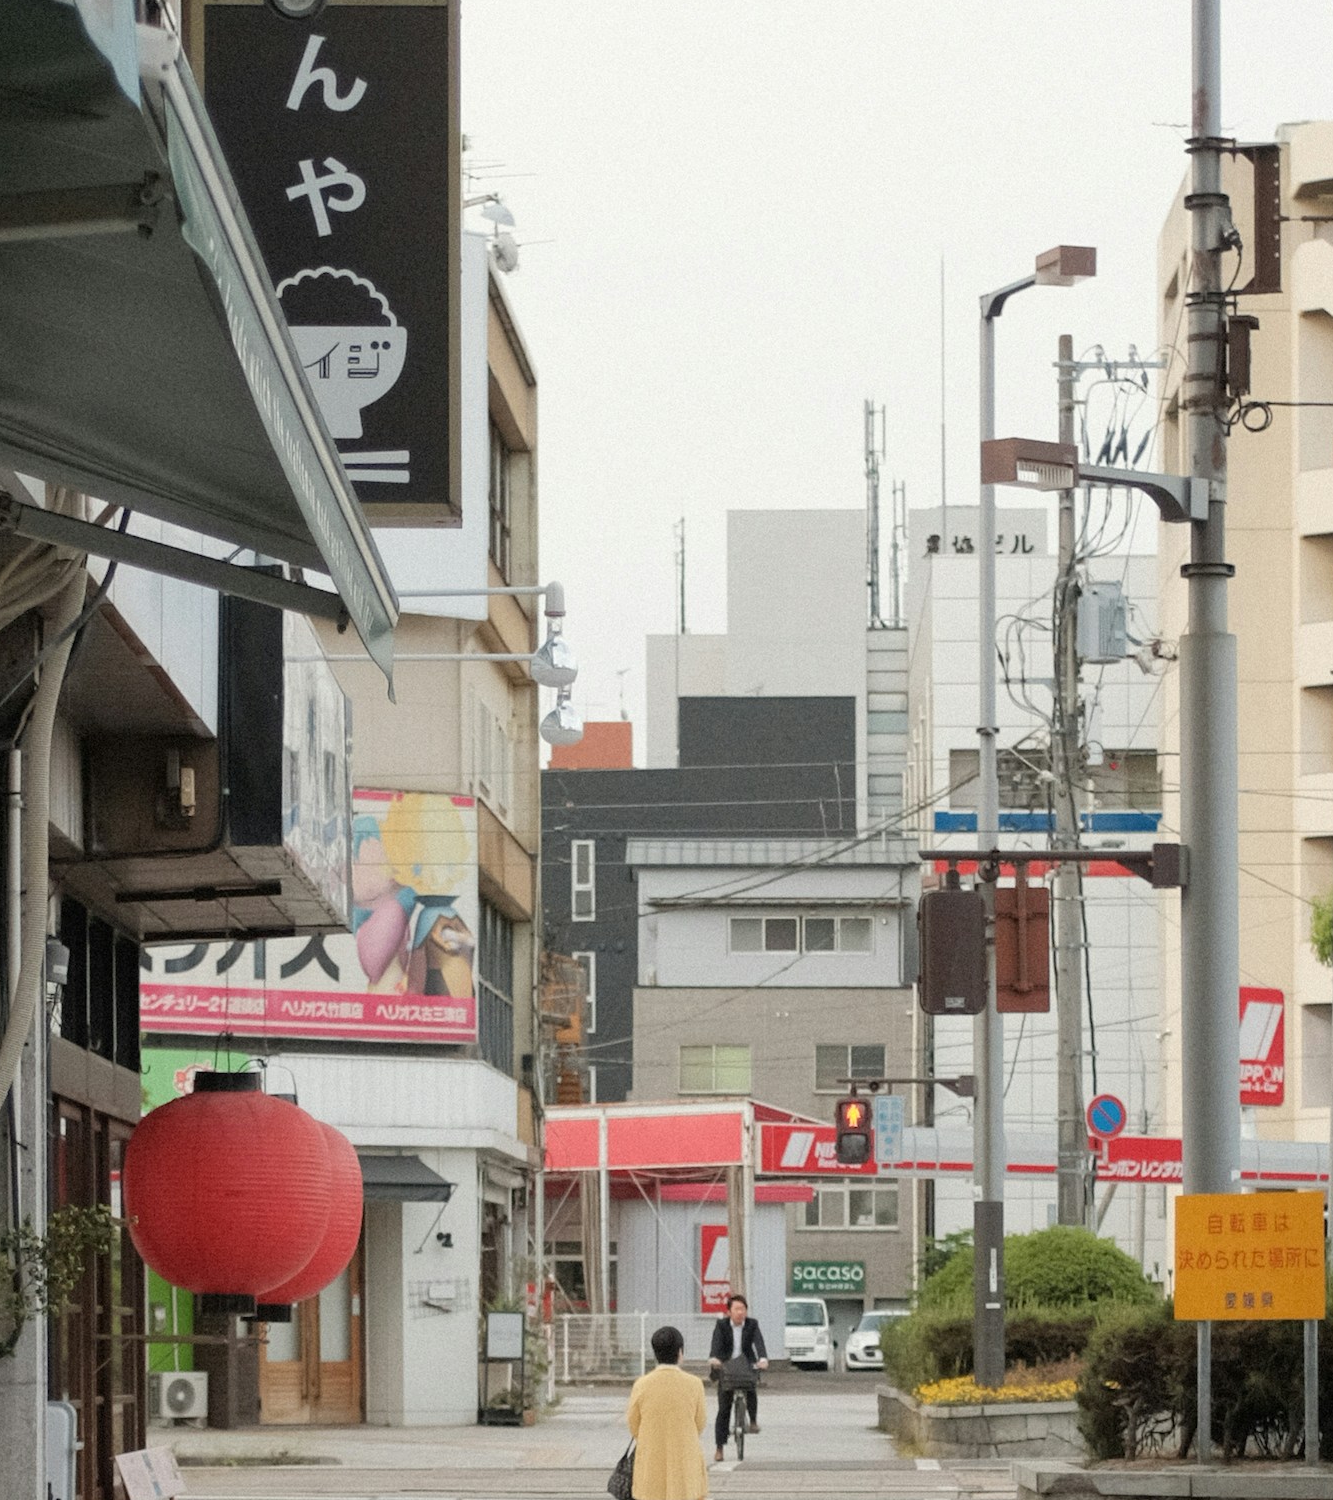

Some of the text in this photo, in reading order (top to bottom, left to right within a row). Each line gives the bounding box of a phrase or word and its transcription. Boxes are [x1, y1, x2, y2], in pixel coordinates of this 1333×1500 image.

[1207, 1212, 1290, 1235] 自転車は
[1178, 1246, 1320, 1271] 決められた場所に
